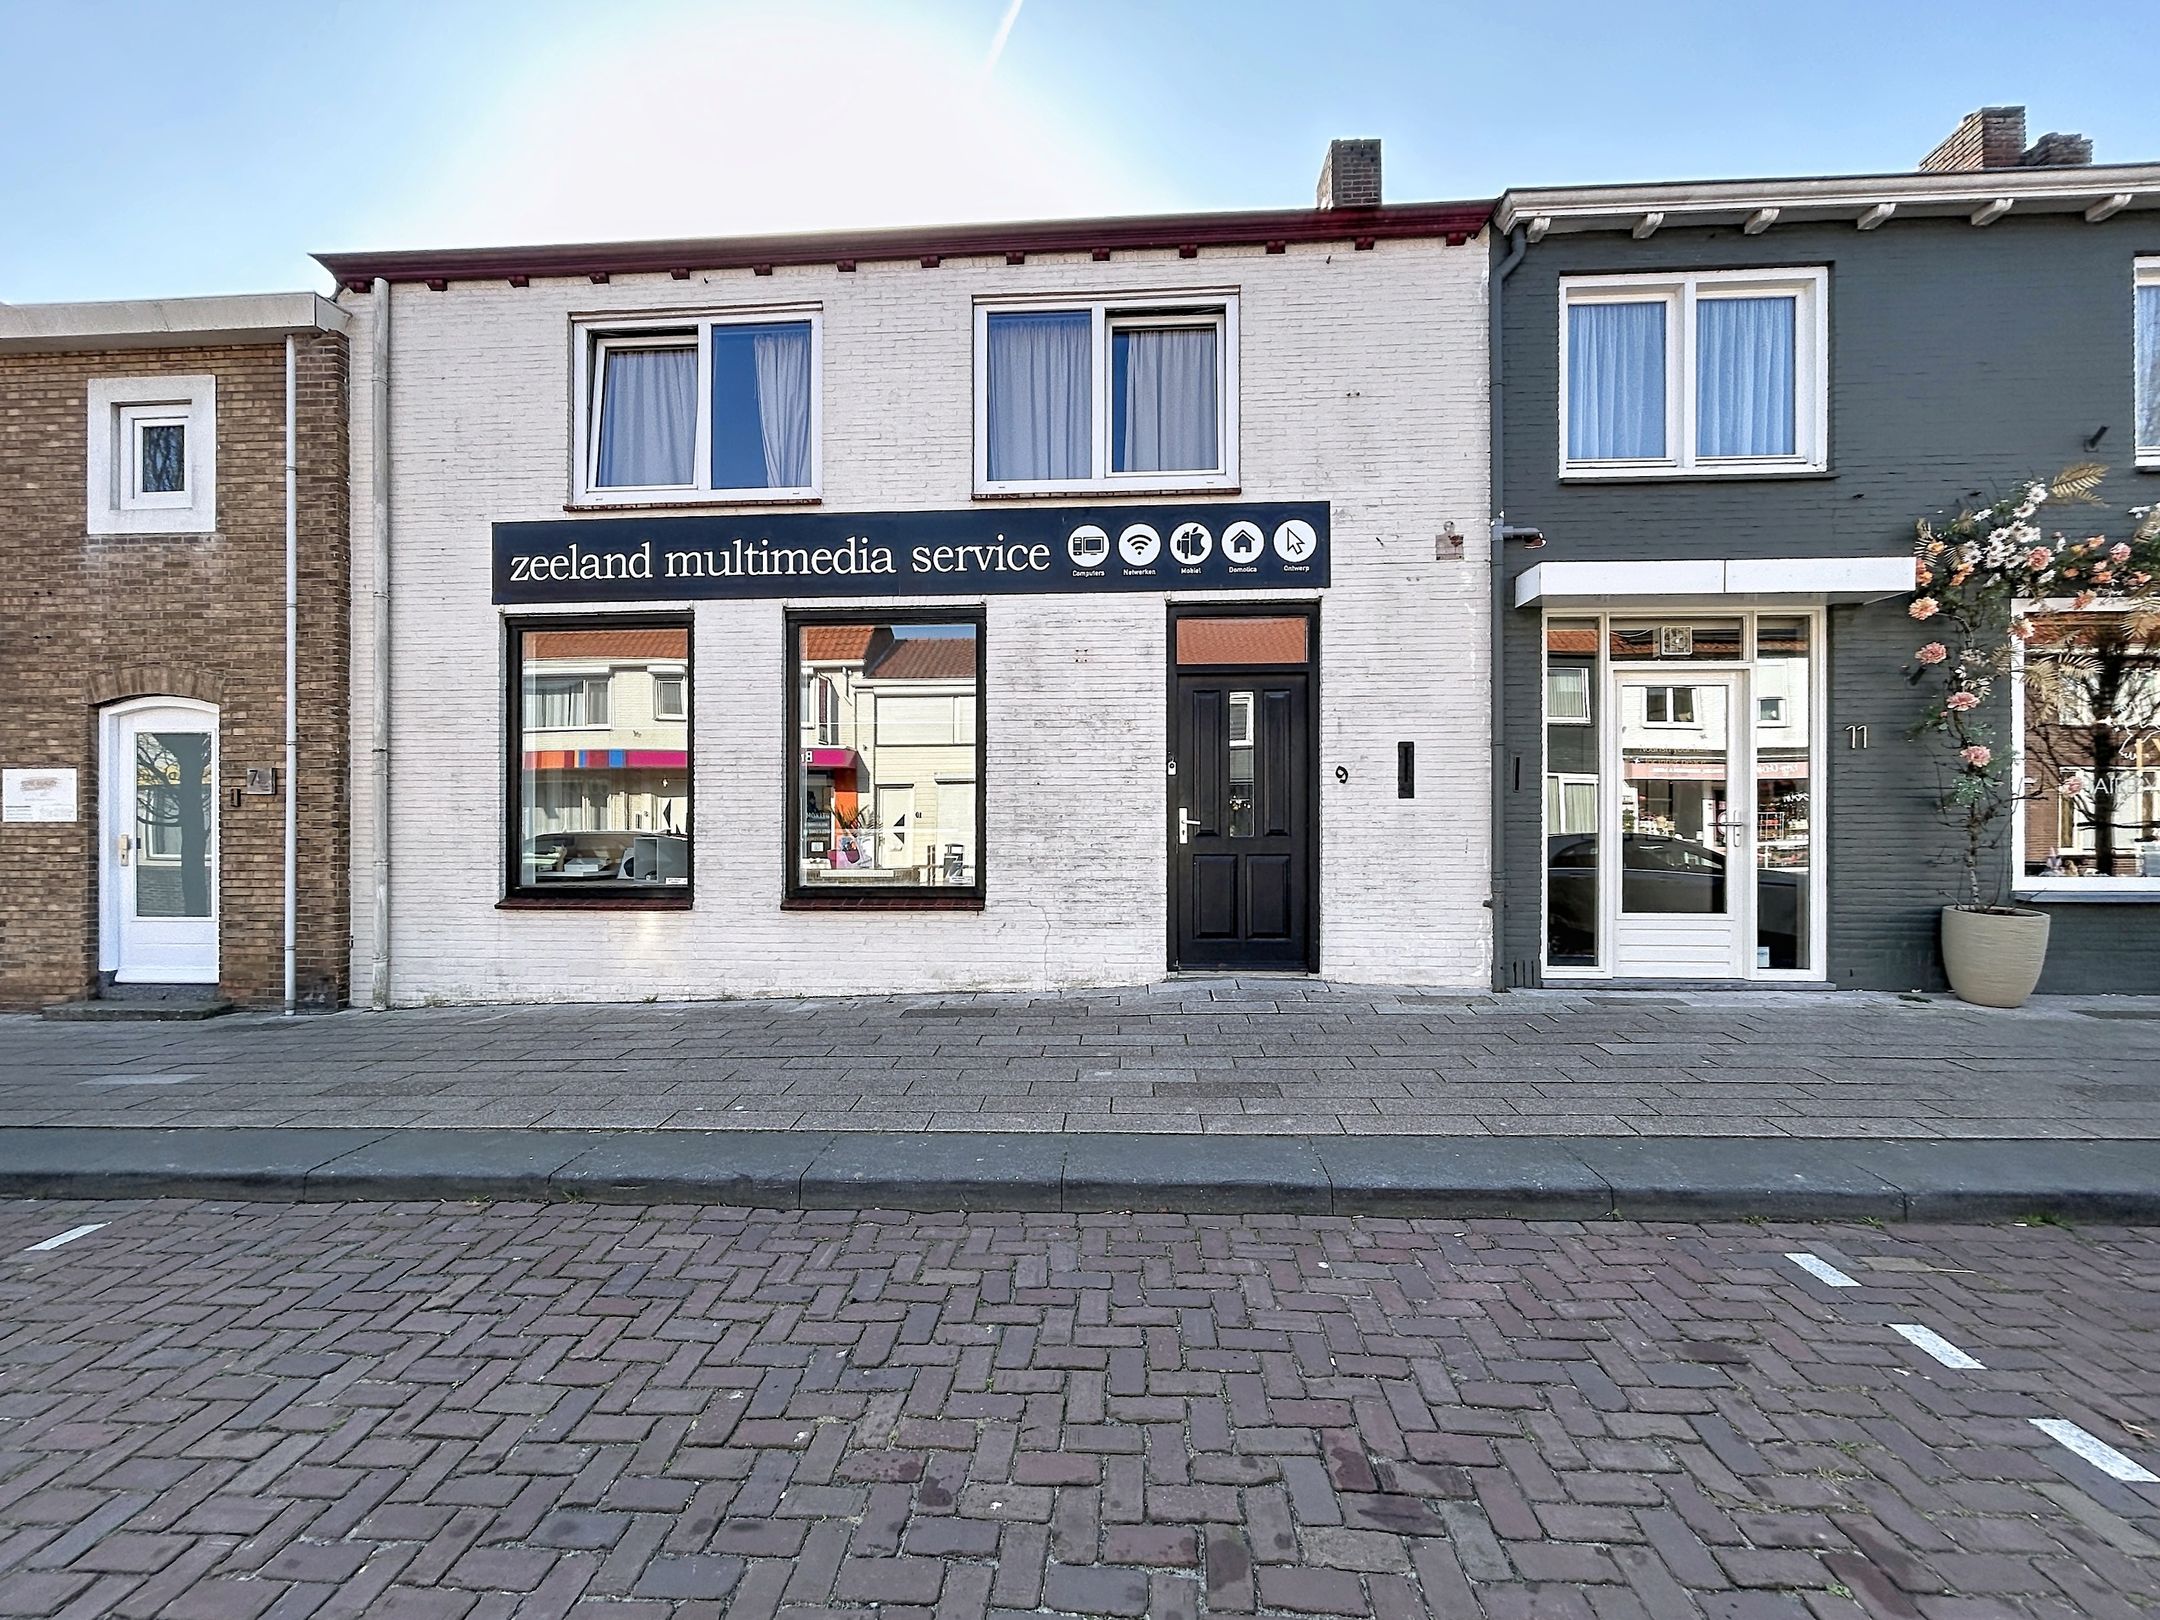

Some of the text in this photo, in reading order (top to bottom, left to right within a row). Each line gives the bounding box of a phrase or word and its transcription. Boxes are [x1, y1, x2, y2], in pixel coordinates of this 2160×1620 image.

[510, 534, 1051, 582] zeeland multimedia service
[1072, 569, 1105, 577] Computers
[1123, 568, 1157, 576] Netwerken
[1845, 725, 1867, 749] 11
[249, 769, 258, 786] 7
[1335, 766, 1348, 784] 9
